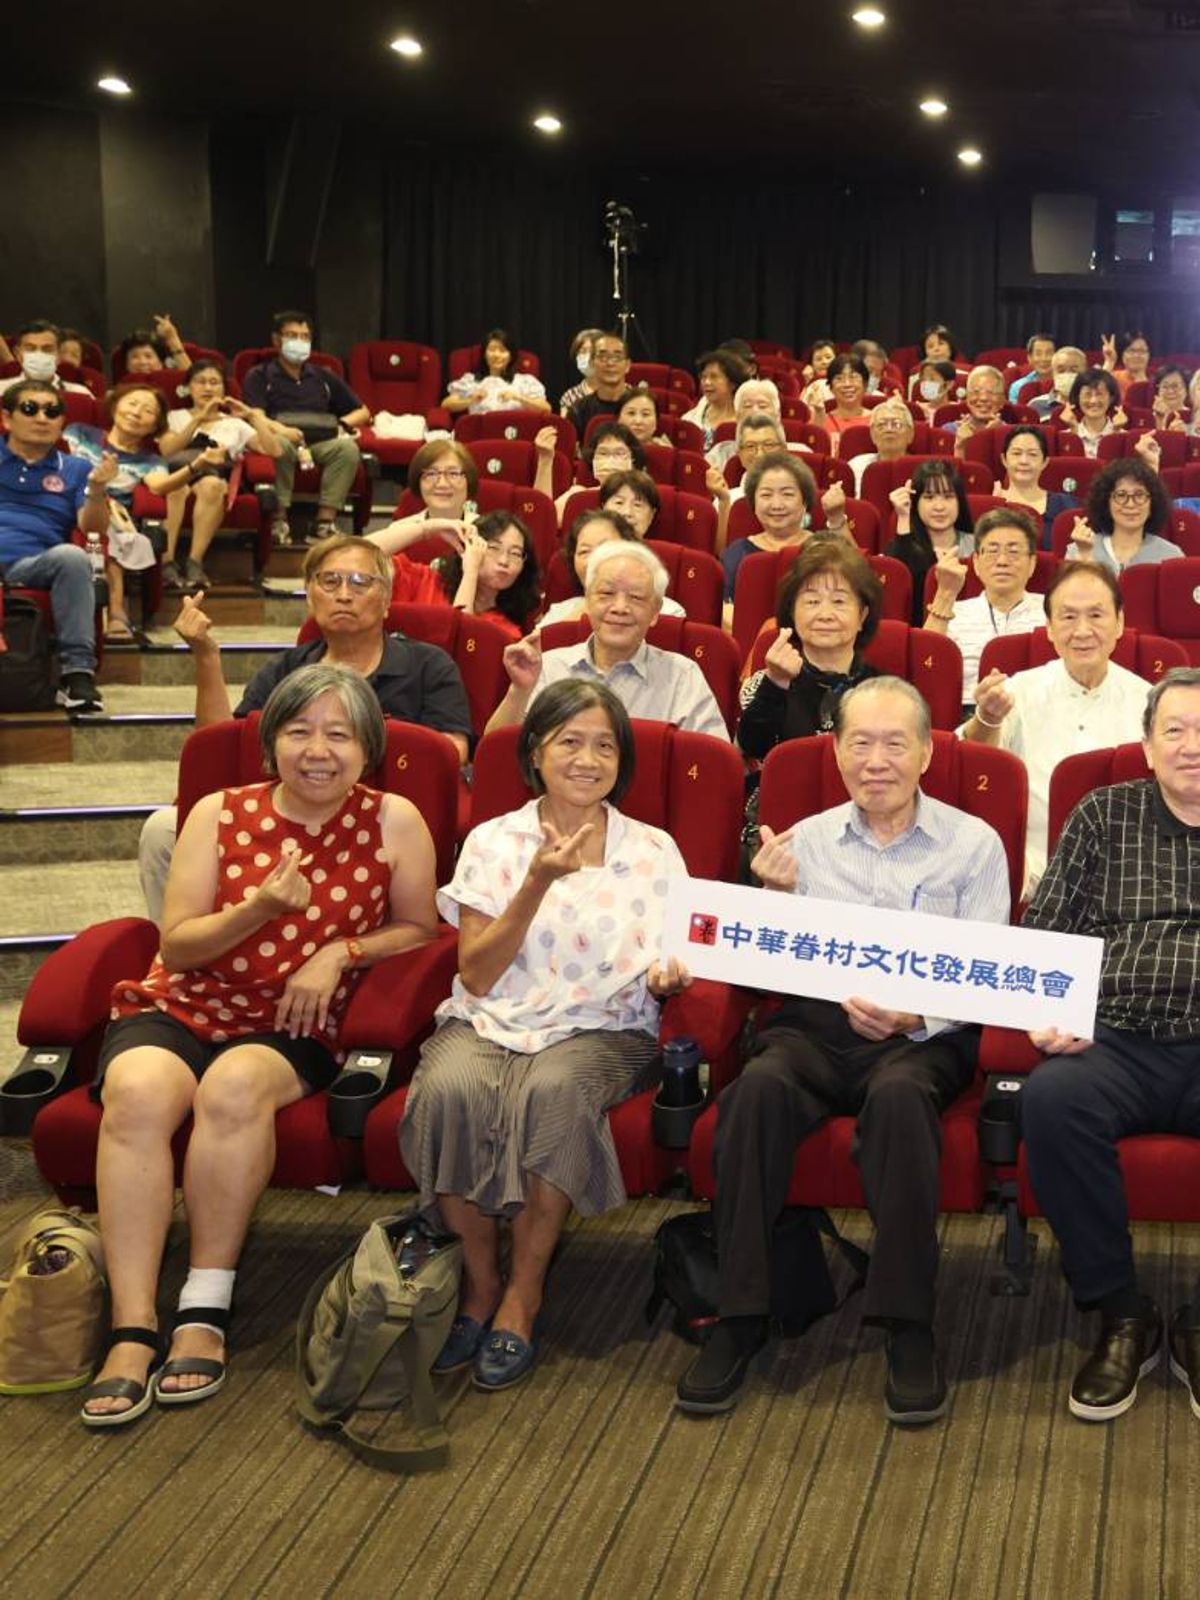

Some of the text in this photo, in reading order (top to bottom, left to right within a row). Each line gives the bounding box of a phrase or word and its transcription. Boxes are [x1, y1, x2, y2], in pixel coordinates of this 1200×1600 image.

[523, 502, 534, 513] 10
[687, 567, 696, 578] 6
[466, 638, 476, 652] 8
[694, 645, 704, 658] 6
[924, 655, 933, 668] 4
[1153, 660, 1164, 673] 2
[397, 753, 408, 769] 6
[688, 763, 699, 780] 4
[976, 774, 989, 791] 2
[722, 921, 1074, 998] 中華眷村文化發展總會
